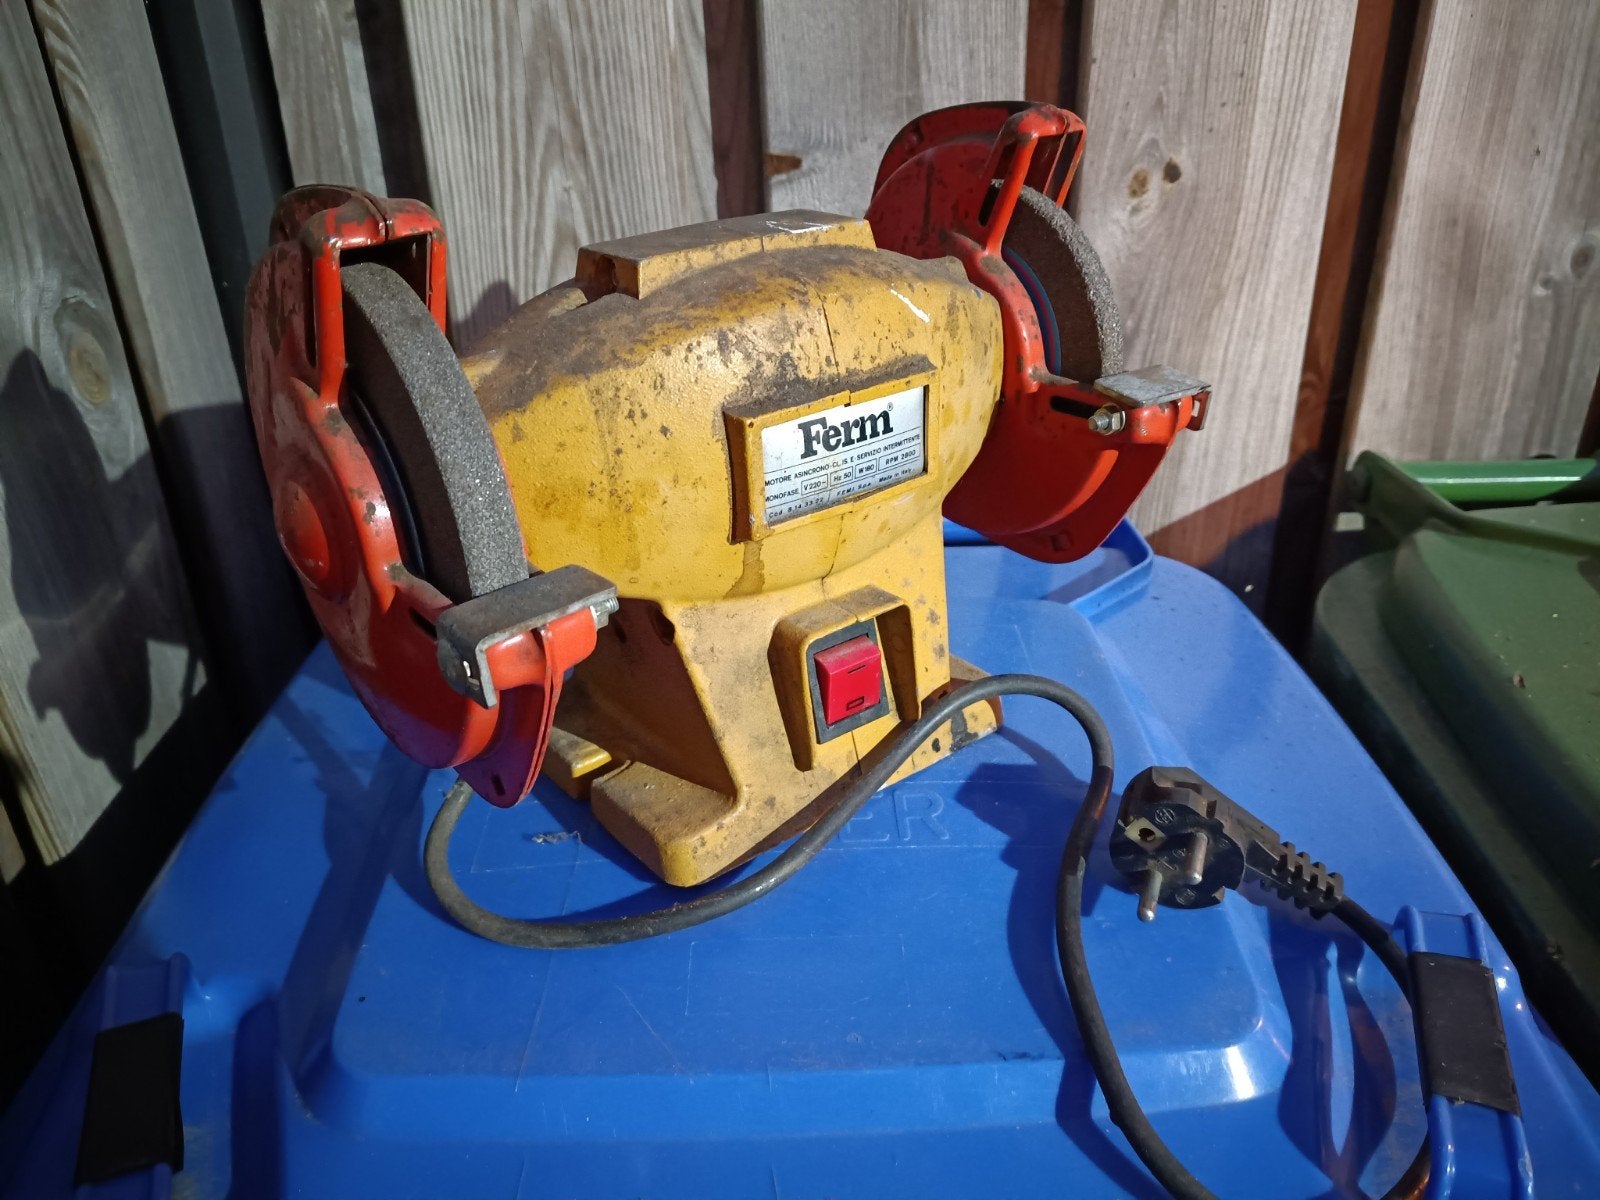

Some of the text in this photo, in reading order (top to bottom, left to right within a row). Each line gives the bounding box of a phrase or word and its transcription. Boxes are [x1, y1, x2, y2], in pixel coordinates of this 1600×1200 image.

[764, 474, 792, 487] MOTORE
[794, 464, 830, 480] ASINCRONO
[856, 447, 882, 461] SERVIZIO
[883, 434, 921, 453] INTERMITTENTE
[833, 473, 842, 482] Hz
[843, 471, 852, 480] 50
[885, 456, 899, 466] RPM
[901, 449, 916, 461] 2800
[879, 474, 893, 484] Made
[894, 471, 900, 479] in
